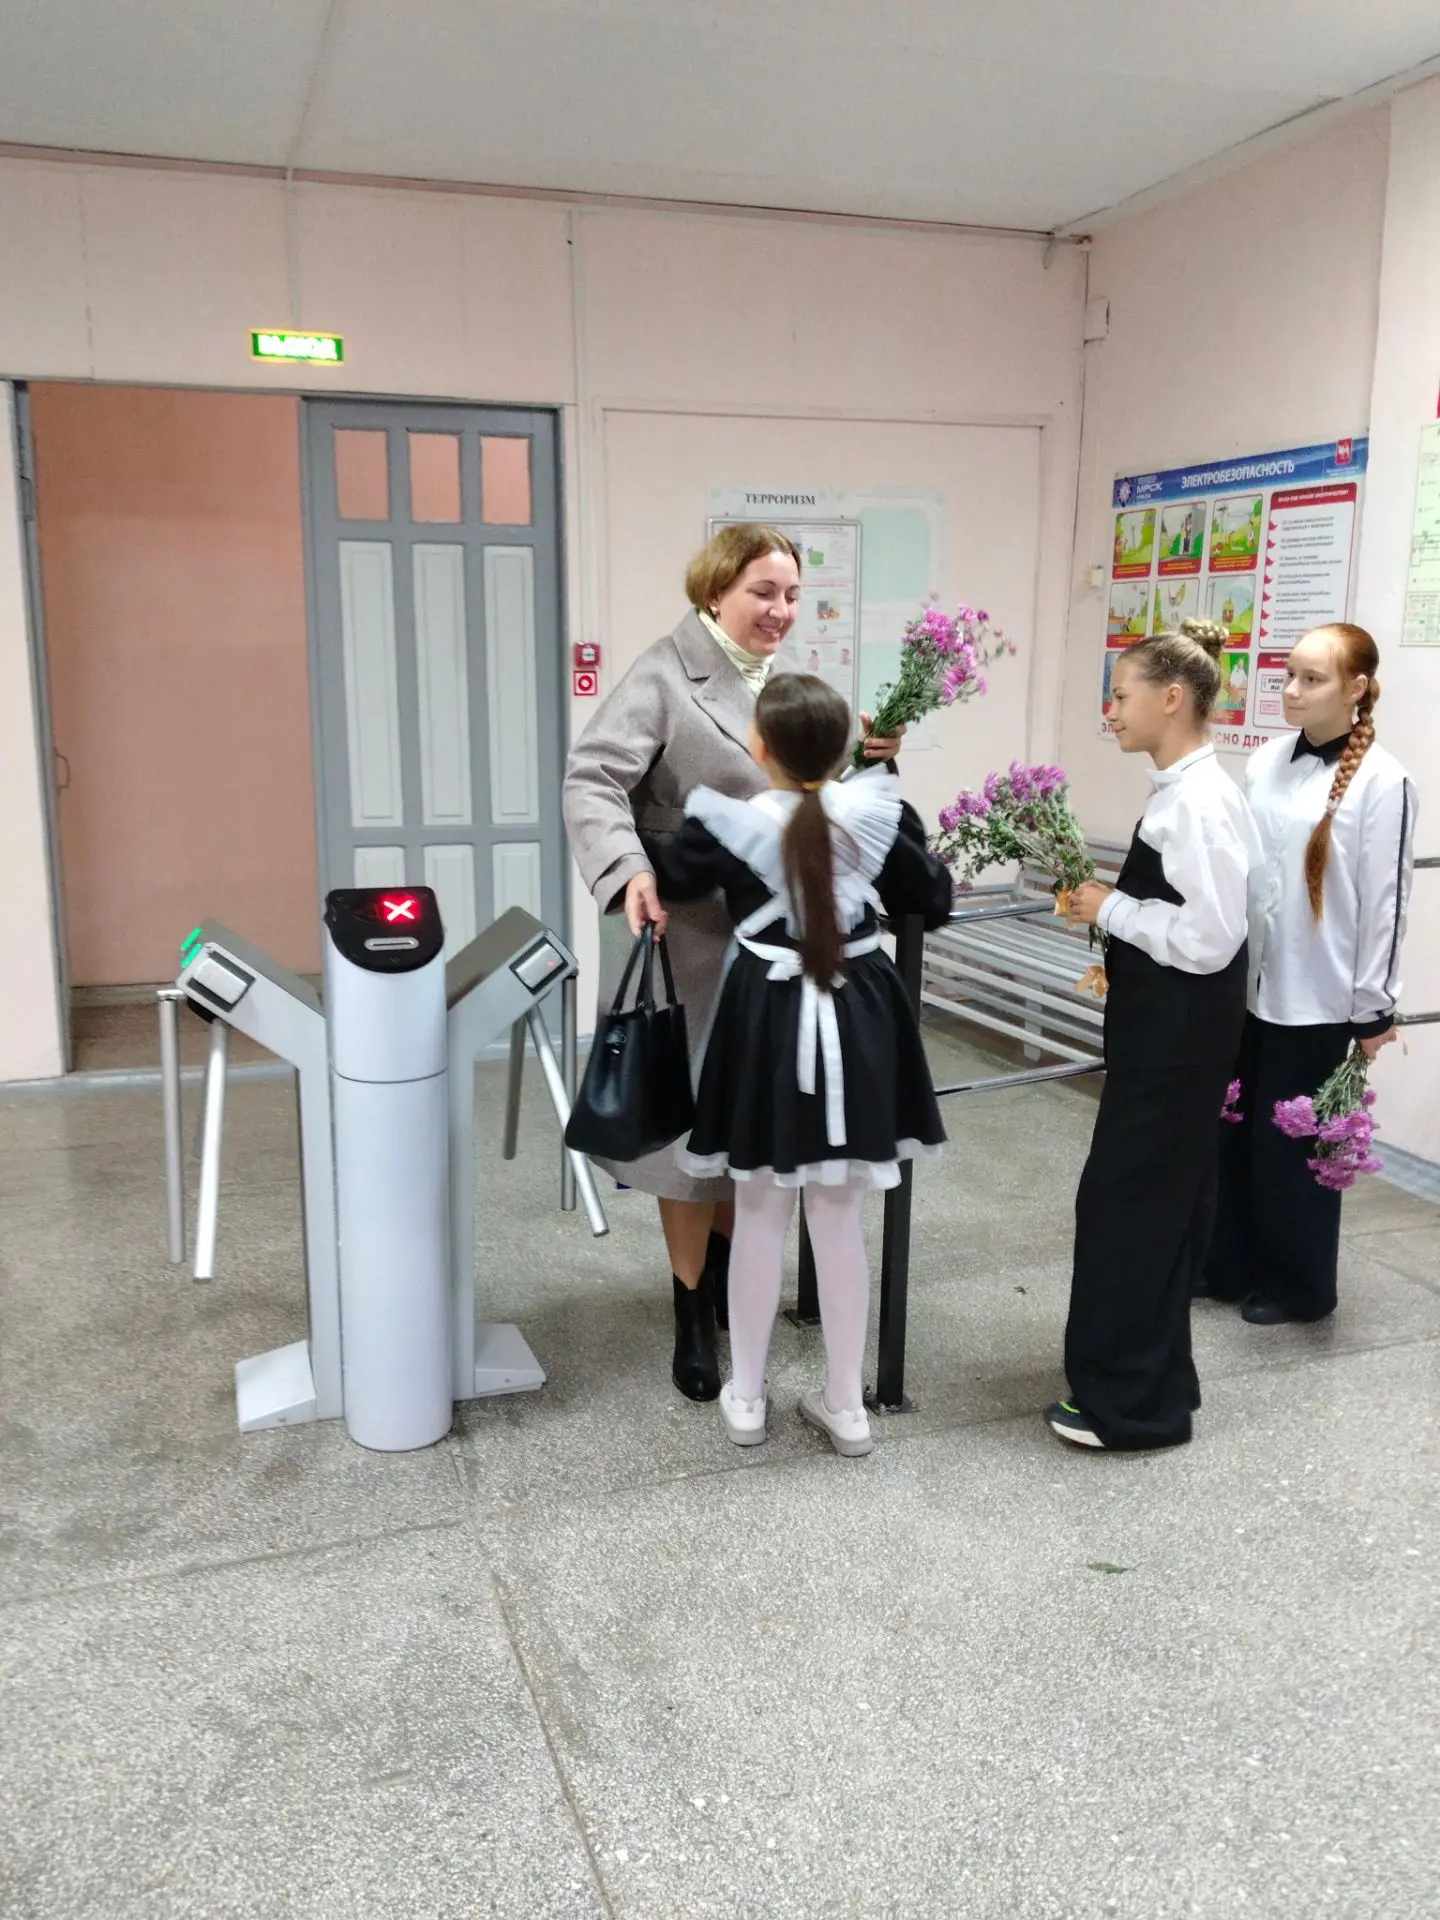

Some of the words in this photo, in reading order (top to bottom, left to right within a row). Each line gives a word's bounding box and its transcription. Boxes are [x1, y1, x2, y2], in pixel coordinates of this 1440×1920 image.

[1181, 460, 1295, 489] ЭЛЕКТРОБЕЗОПАСНОСТЬ
[1136, 482, 1162, 495] МРСК
[745, 493, 816, 505] ТЕРРОРИЗМ
[1213, 731, 1240, 745] СНО
